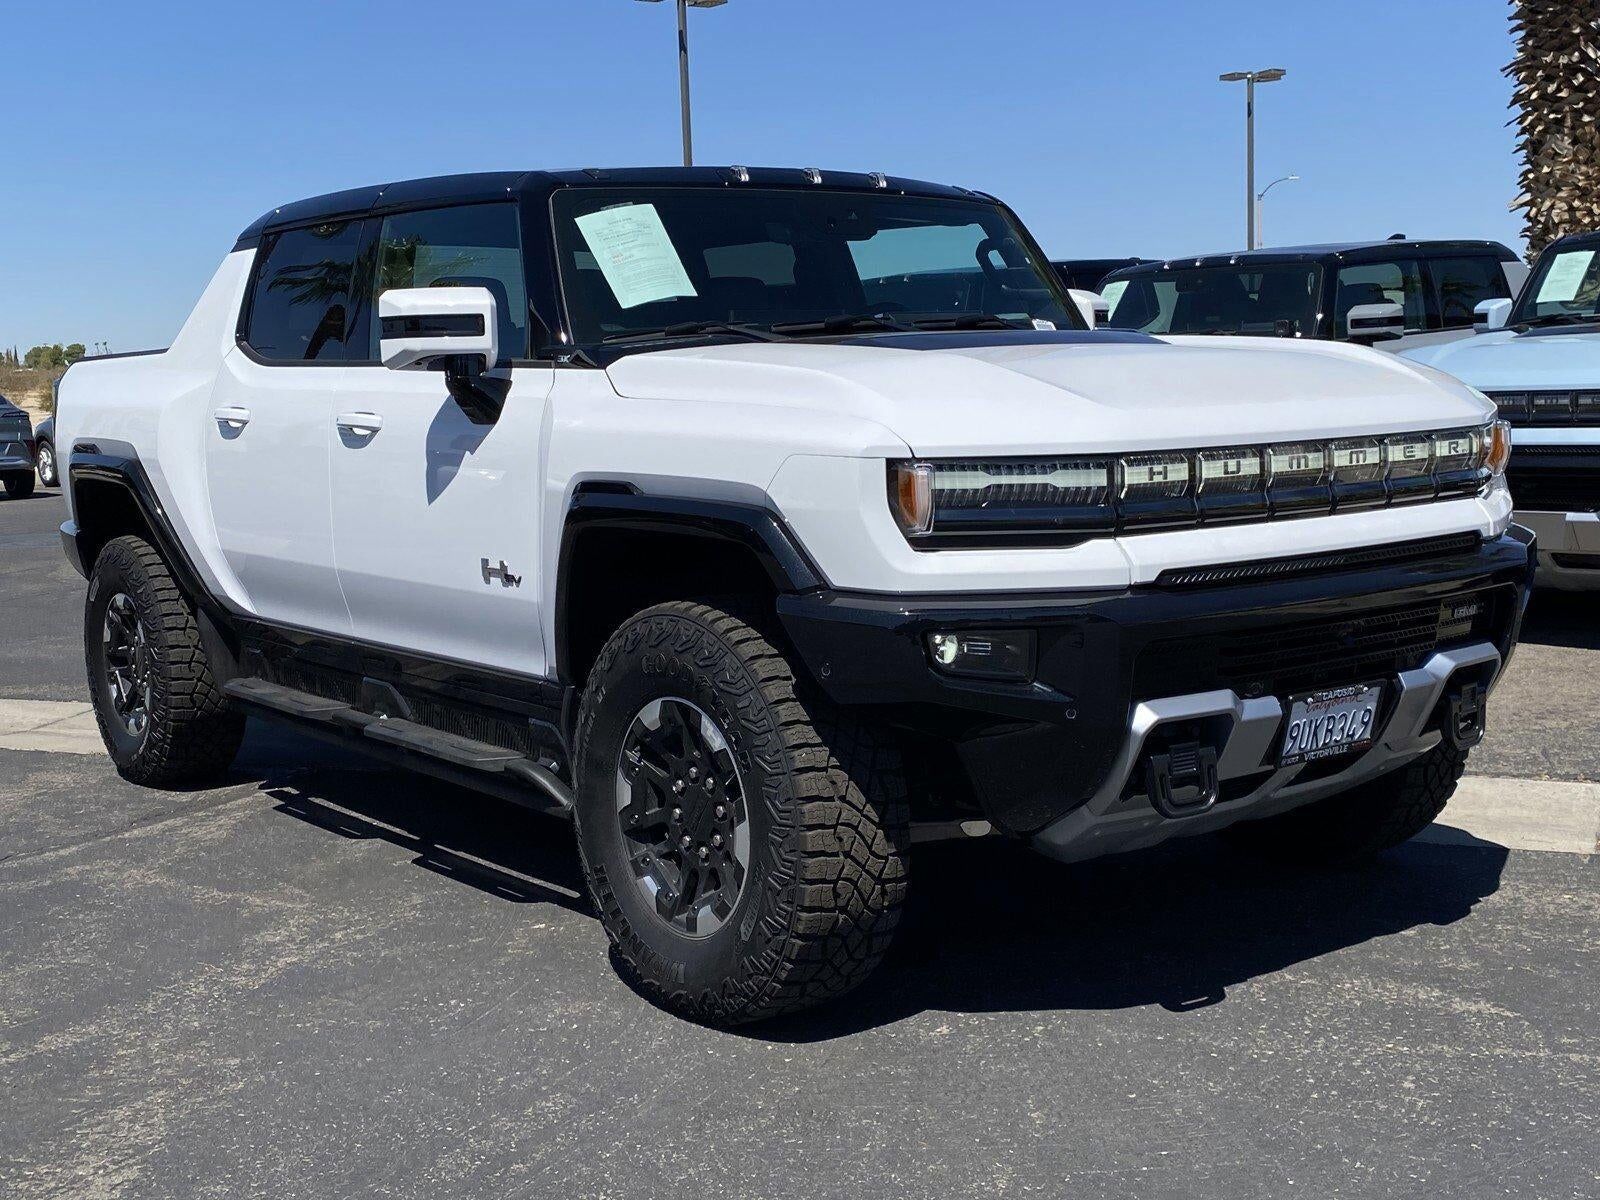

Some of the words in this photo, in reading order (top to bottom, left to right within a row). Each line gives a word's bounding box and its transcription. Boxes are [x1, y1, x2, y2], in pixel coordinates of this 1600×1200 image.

[1147, 439, 1468, 481] HUMMER
[1284, 706, 1373, 756] 9UKB349
[1304, 744, 1349, 761] VICTORVILLE
